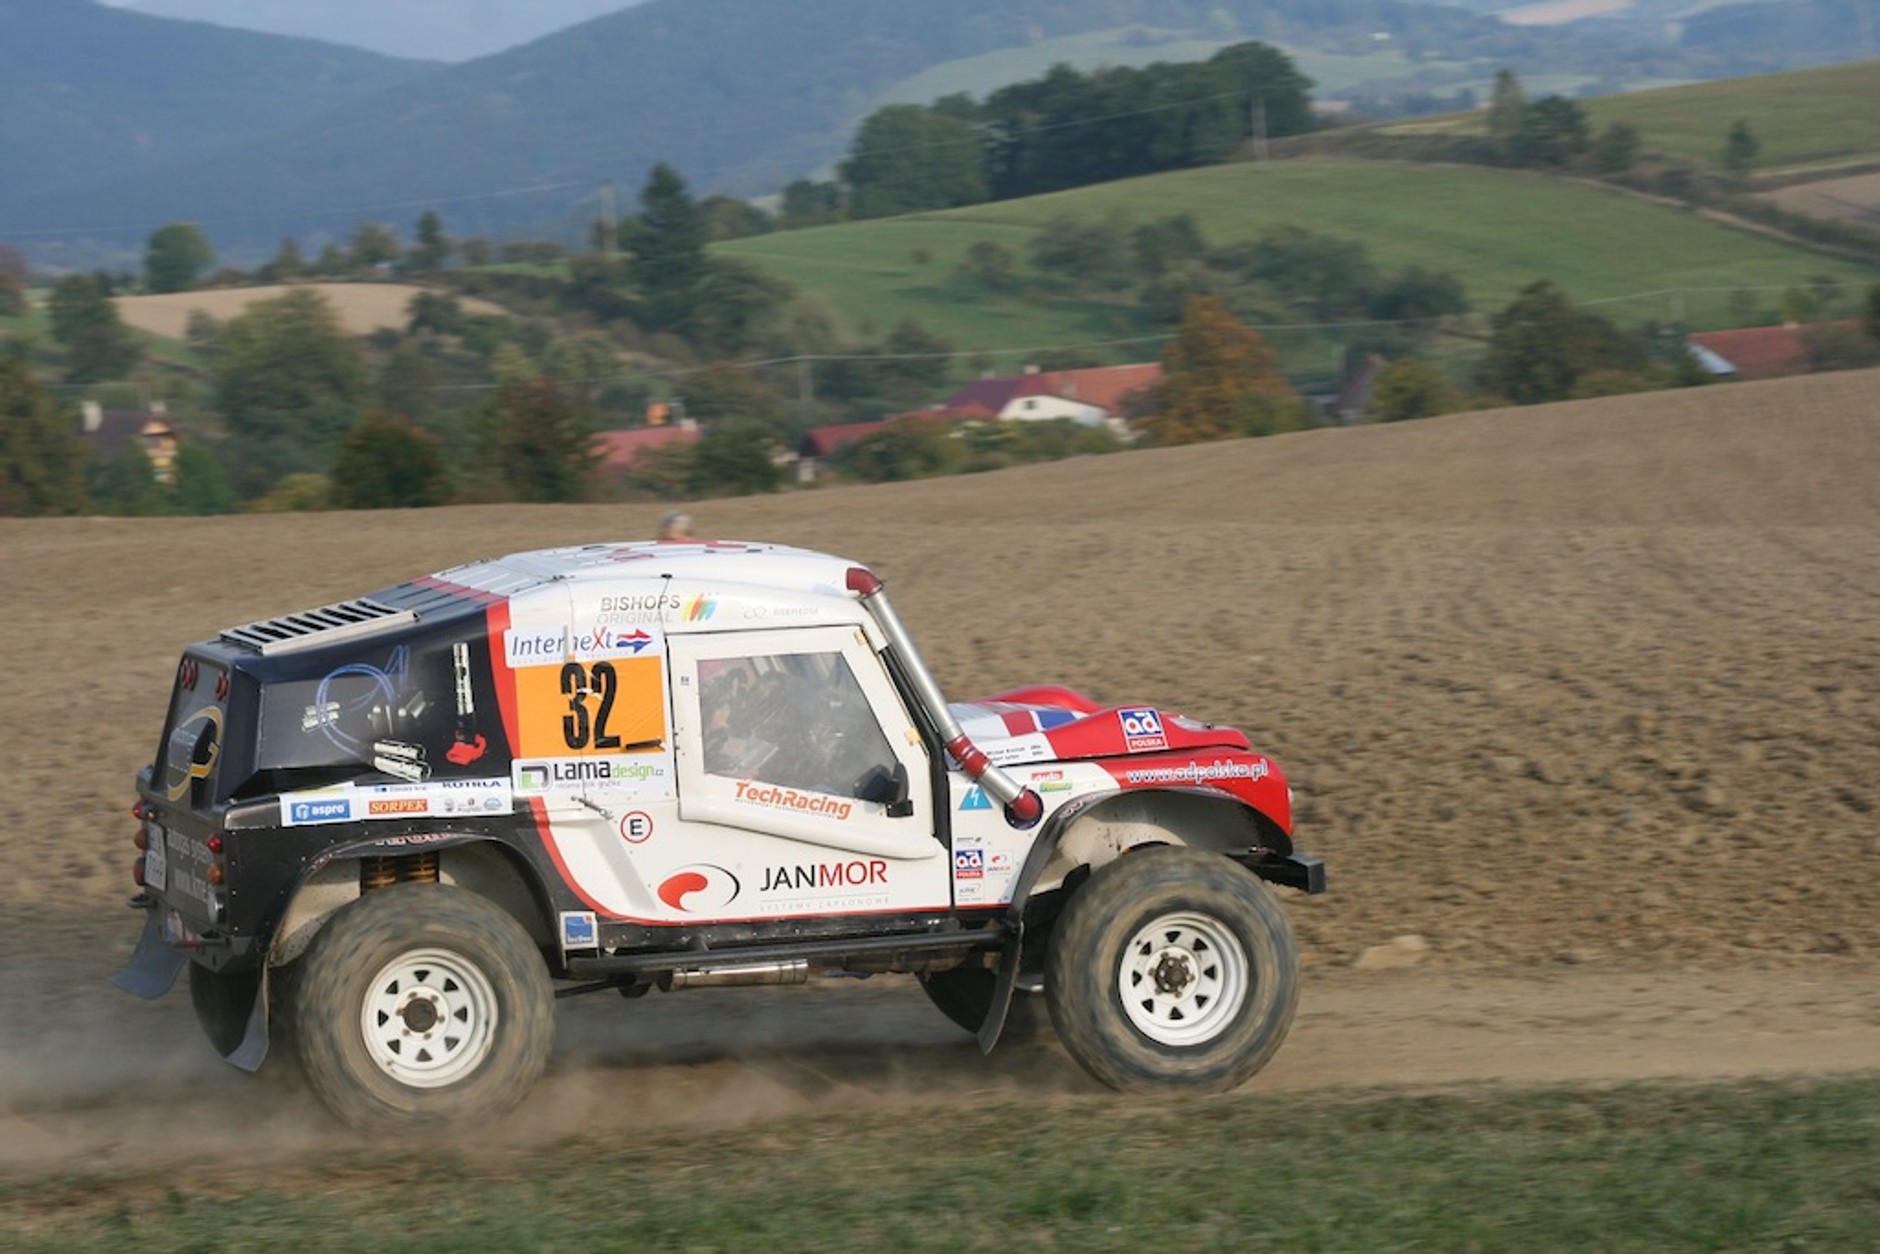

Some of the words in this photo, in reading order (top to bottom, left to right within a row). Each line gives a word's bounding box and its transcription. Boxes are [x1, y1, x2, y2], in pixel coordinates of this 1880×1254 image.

[600, 594, 681, 612] BISHOPS
[597, 611, 674, 625] ORIGINAL
[560, 660, 621, 750] 32
[1131, 739, 1163, 747] POLSKA
[1127, 758, 1269, 784] www.adpolska.pl
[311, 804, 346, 816] aspro
[370, 800, 426, 813] SORPEK
[736, 782, 853, 821] TechRacing
[629, 818, 643, 836] E
[759, 860, 888, 892] JANMOR
